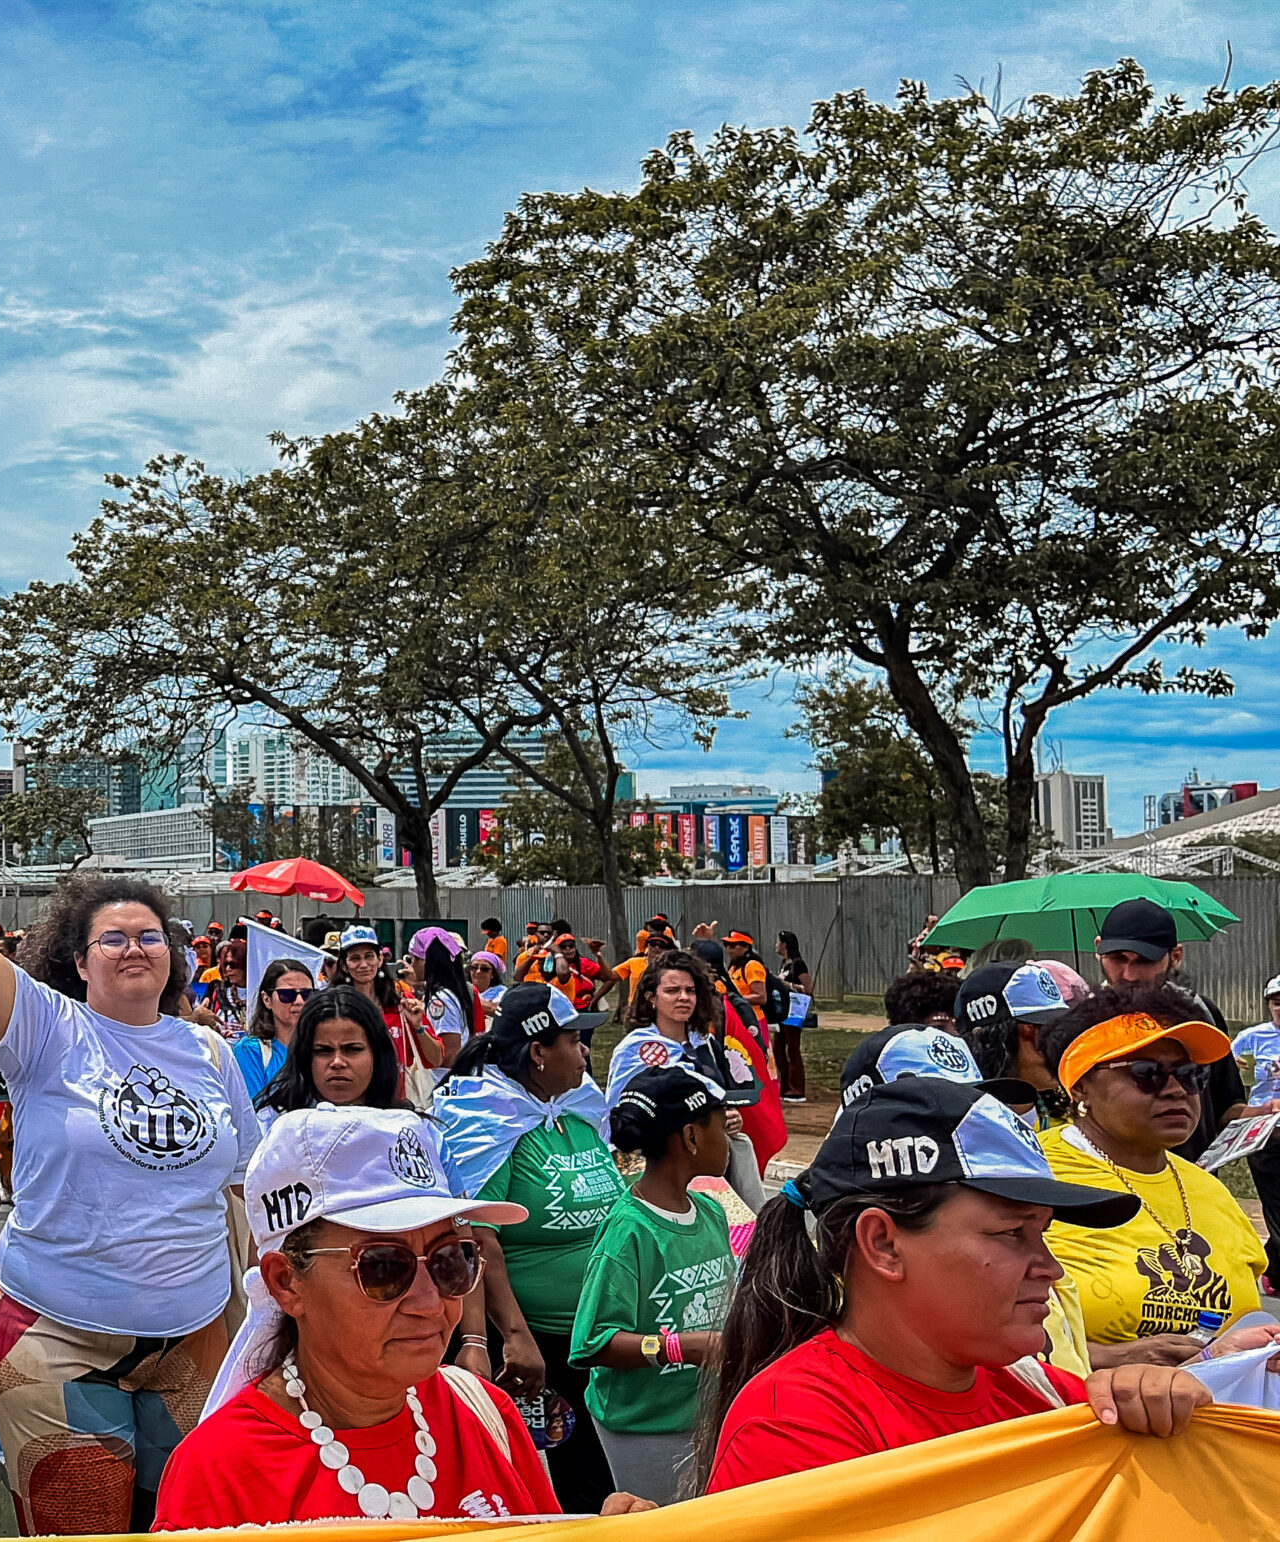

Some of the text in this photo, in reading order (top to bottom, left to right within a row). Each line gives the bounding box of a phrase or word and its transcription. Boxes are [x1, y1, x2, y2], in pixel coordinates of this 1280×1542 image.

[383, 823, 393, 848] BRB
[729, 817, 740, 863] Senac
[521, 1011, 550, 1037] MTD
[966, 994, 997, 1022] MTD
[684, 1091, 708, 1111] MTD
[120, 1100, 199, 1149] MTD
[108, 1134, 157, 1171] Trabalhadoras
[166, 1141, 215, 1171] Trabalhadores
[866, 1135, 939, 1179] MTD
[261, 1182, 313, 1232] MTD
